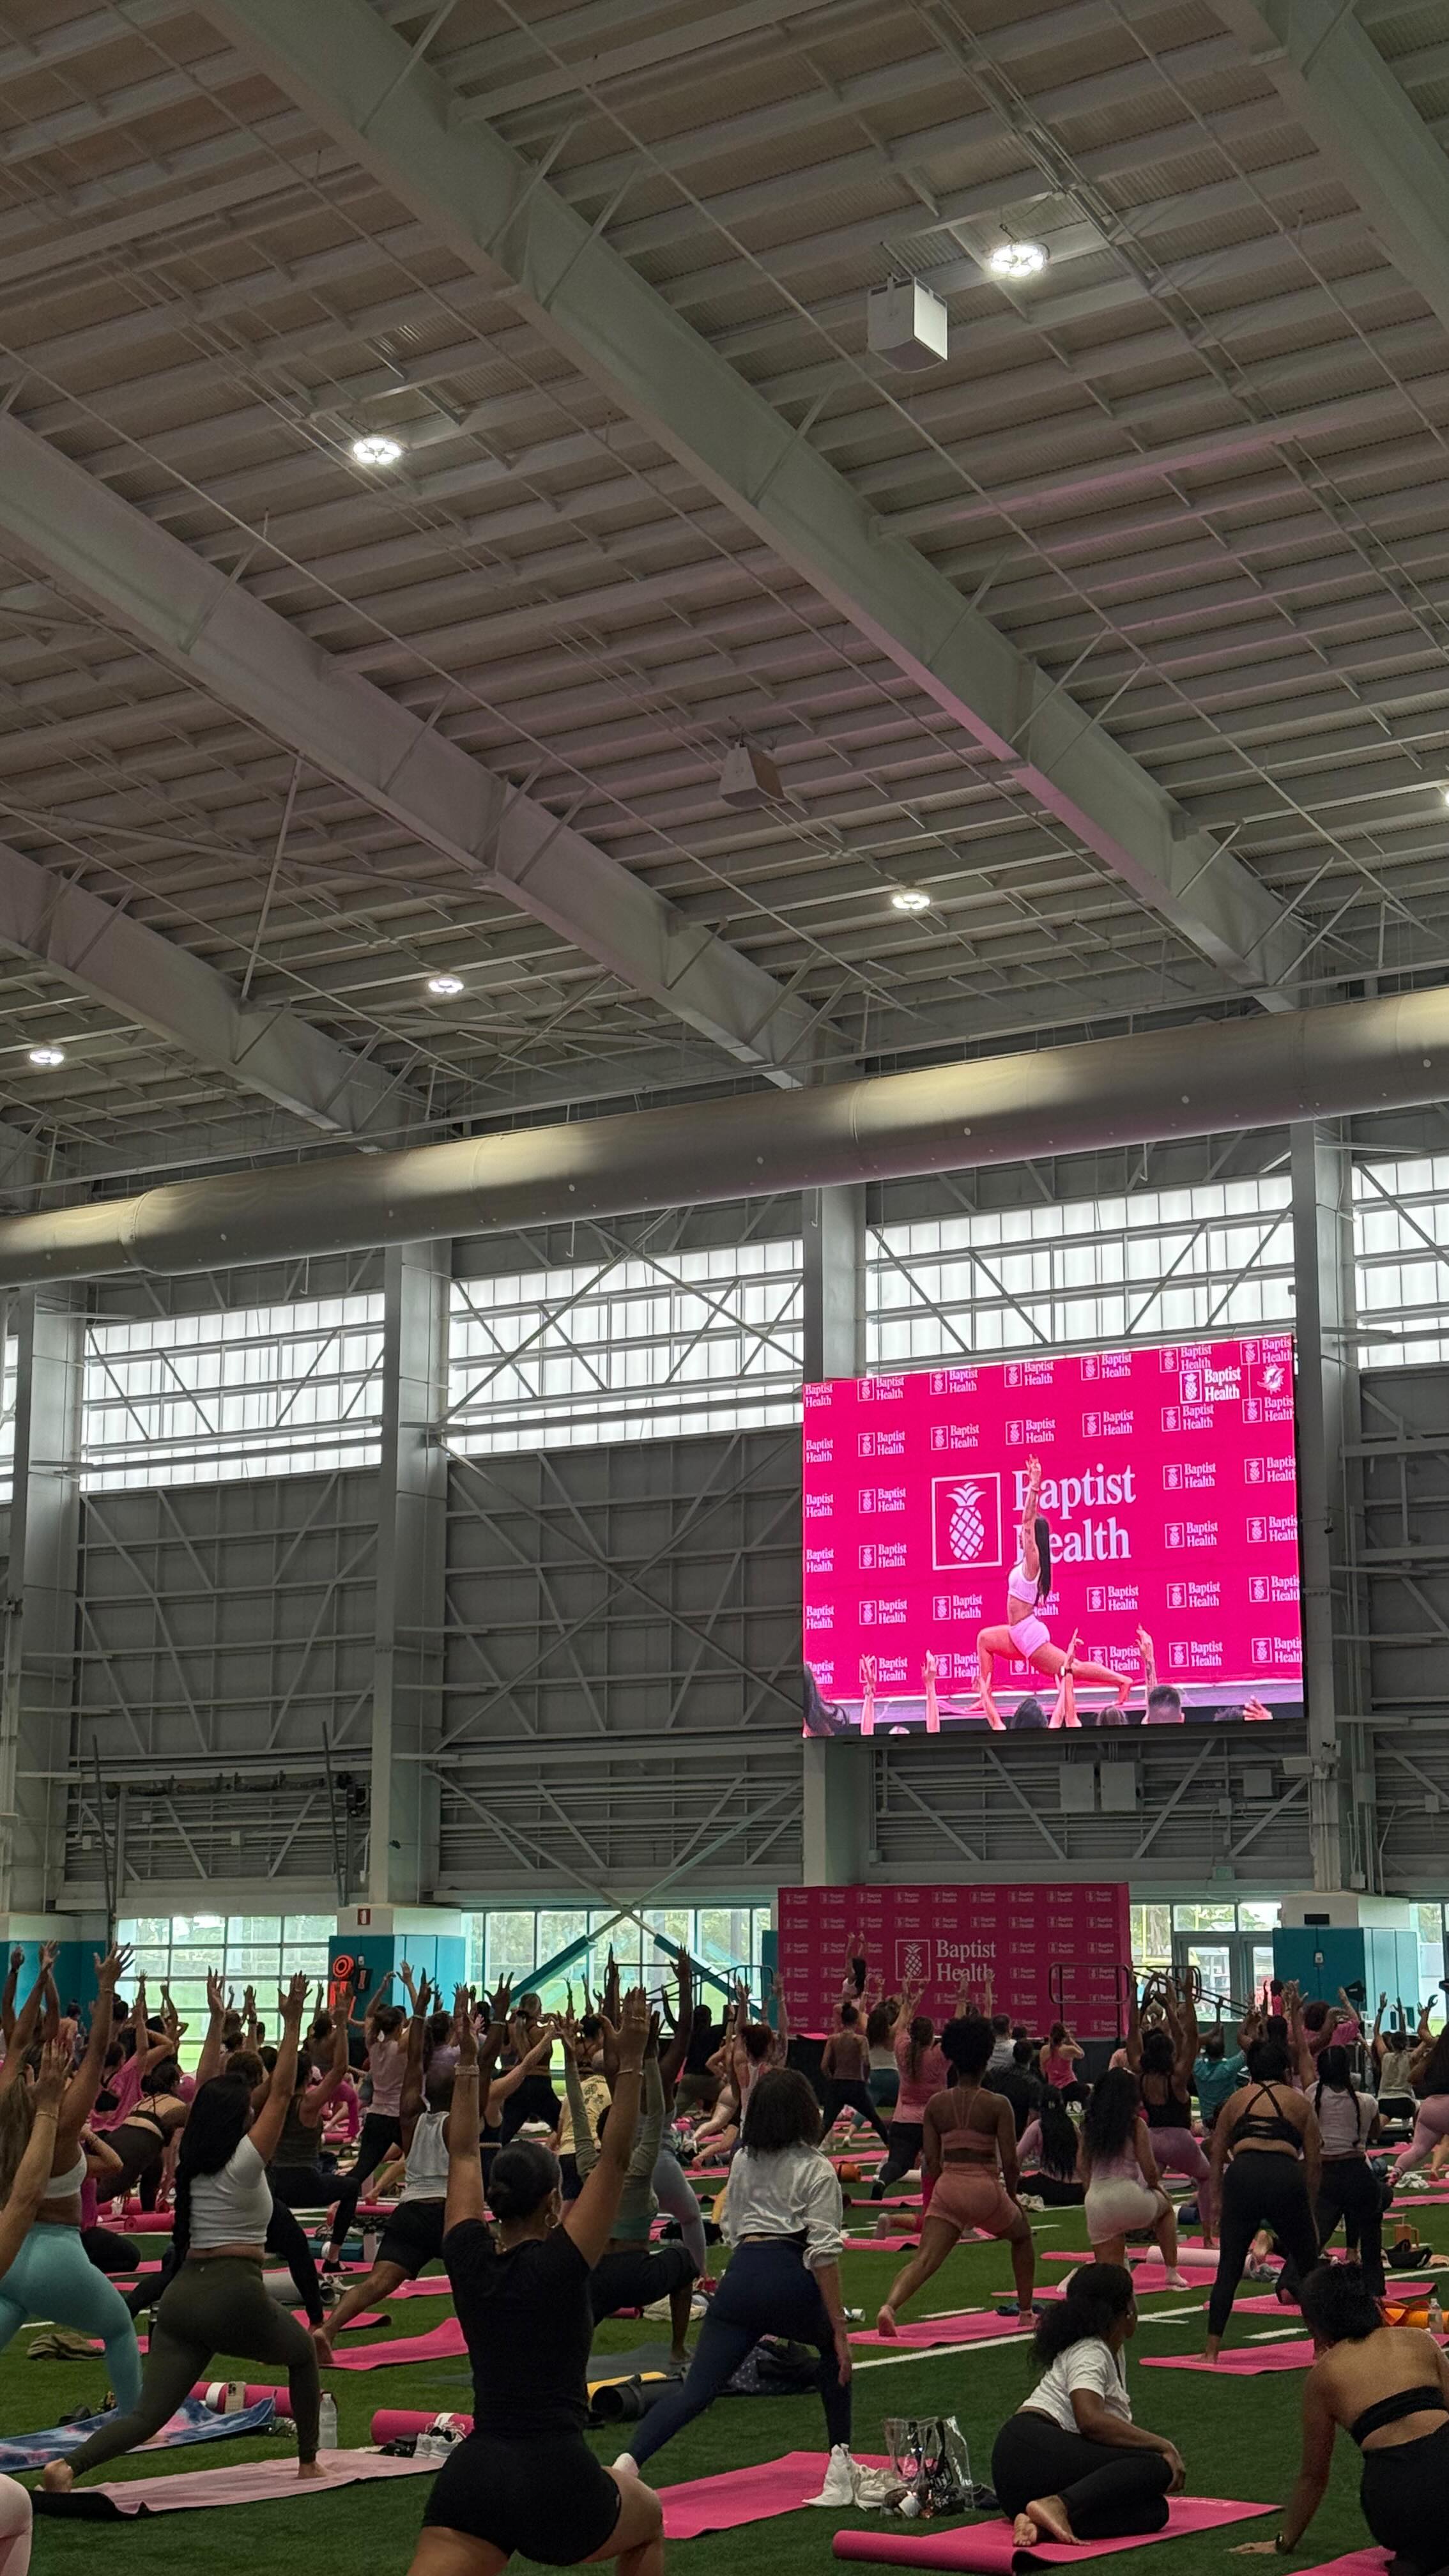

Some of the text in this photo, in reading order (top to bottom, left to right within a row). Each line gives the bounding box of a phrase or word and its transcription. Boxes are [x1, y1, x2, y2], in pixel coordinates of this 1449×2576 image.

[1262, 1337, 1292, 1352] Baptis
[1181, 1345, 1211, 1358] Baptist
[1102, 1353, 1131, 1366] Baptist
[1181, 1357, 1211, 1370] Health
[1024, 1361, 1054, 1375] Baptist
[1102, 1365, 1131, 1378] Health
[949, 1369, 978, 1383] Baptist
[1024, 1373, 1053, 1386] Health
[1204, 1366, 1241, 1386] Baptist
[805, 1383, 832, 1396] Baptist
[877, 1377, 904, 1391] Baptist
[949, 1381, 977, 1393] Health
[877, 1389, 903, 1400] Health
[1204, 1384, 1239, 1402] Health
[806, 1395, 832, 1407] Health
[1265, 1395, 1293, 1411] Baptis
[1103, 1409, 1134, 1423] Baptist
[1183, 1404, 1214, 1418] Baptist
[1026, 1418, 1055, 1432] Baptist
[1103, 1422, 1133, 1435] Health
[1183, 1416, 1213, 1430] Health
[951, 1423, 979, 1438] Baptist
[1026, 1430, 1054, 1443] Health
[877, 1430, 905, 1445] Baptist
[951, 1436, 978, 1448] Health
[806, 1438, 833, 1452] Baptist
[877, 1443, 904, 1455] Health
[806, 1451, 832, 1462] Health
[1267, 1455, 1296, 1470] Baptis
[1184, 1462, 1216, 1475] Baptist
[1185, 1475, 1215, 1487] Health
[806, 1493, 833, 1507] Baptist
[878, 1487, 906, 1501] Baptist
[806, 1506, 832, 1518] Health
[878, 1499, 905, 1512] Health
[1186, 1521, 1218, 1534] Baptist
[1269, 1514, 1298, 1530] Baptis
[1187, 1533, 1216, 1547] Health
[806, 1547, 834, 1561] Baptist
[878, 1543, 907, 1556] Baptist
[806, 1560, 832, 1572] Health
[878, 1555, 906, 1568] Health
[1188, 1581, 1220, 1594] Baptist
[1271, 1574, 1300, 1590] Baptis
[1108, 1584, 1138, 1597] Baptist
[879, 1598, 907, 1611] Baptist
[953, 1595, 982, 1607] Baptist
[1108, 1598, 1138, 1610] Health
[1189, 1594, 1219, 1607] Health
[806, 1604, 834, 1616] Baptist
[953, 1607, 981, 1620] Health
[806, 1616, 832, 1629] Health
[879, 1611, 907, 1624] Health
[1191, 1641, 1223, 1653] Baptist
[1274, 1636, 1301, 1651] Bapti
[879, 1656, 908, 1669] Baptist
[954, 1652, 979, 1667] Bapti
[1110, 1659, 1140, 1671] Health
[1192, 1653, 1222, 1666] Health
[814, 1673, 833, 1685] alth
[879, 1669, 907, 1682] Health
[936, 1939, 997, 1963] Baptist
